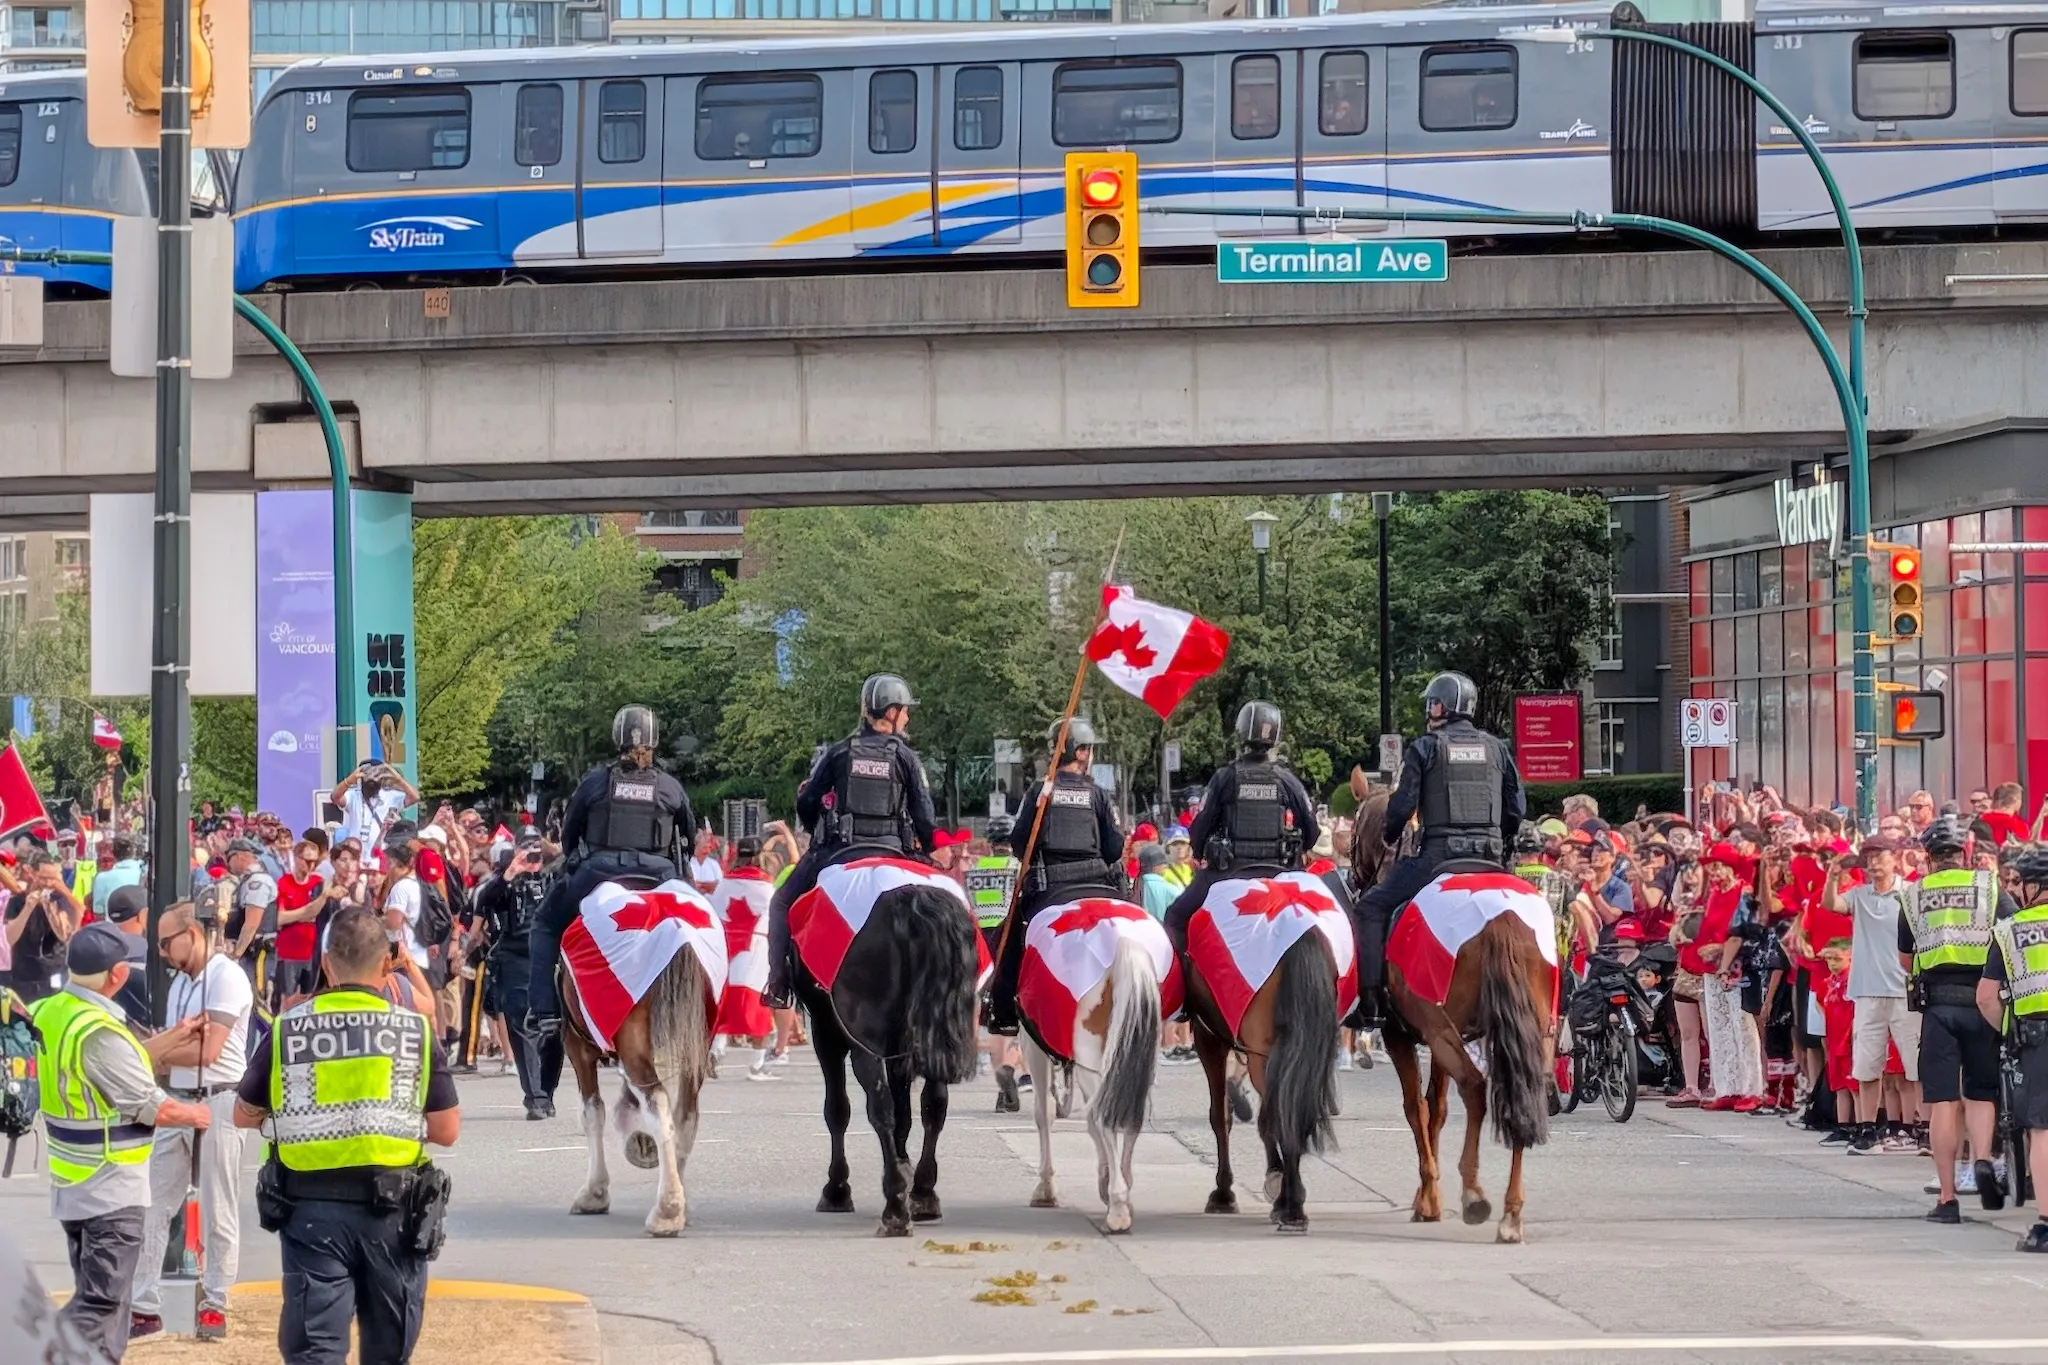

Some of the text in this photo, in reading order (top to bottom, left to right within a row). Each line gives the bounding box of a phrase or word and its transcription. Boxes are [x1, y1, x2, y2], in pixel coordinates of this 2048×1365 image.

[305, 91, 332, 106] 314
[369, 226, 445, 252] SkyTrain
[1234, 247, 1432, 273] Terminal Ave
[426, 296, 449, 311] 440
[1774, 466, 1840, 561] Vancity
[278, 643, 336, 654] VANCOUVE
[367, 633, 405, 669] WE
[852, 765, 890, 777] POLICE
[1053, 794, 1090, 805] POLICE
[1920, 894, 1976, 913] POLICE
[291, 1013, 417, 1032] VANCOUVER
[287, 1029, 421, 1064] POLICE
